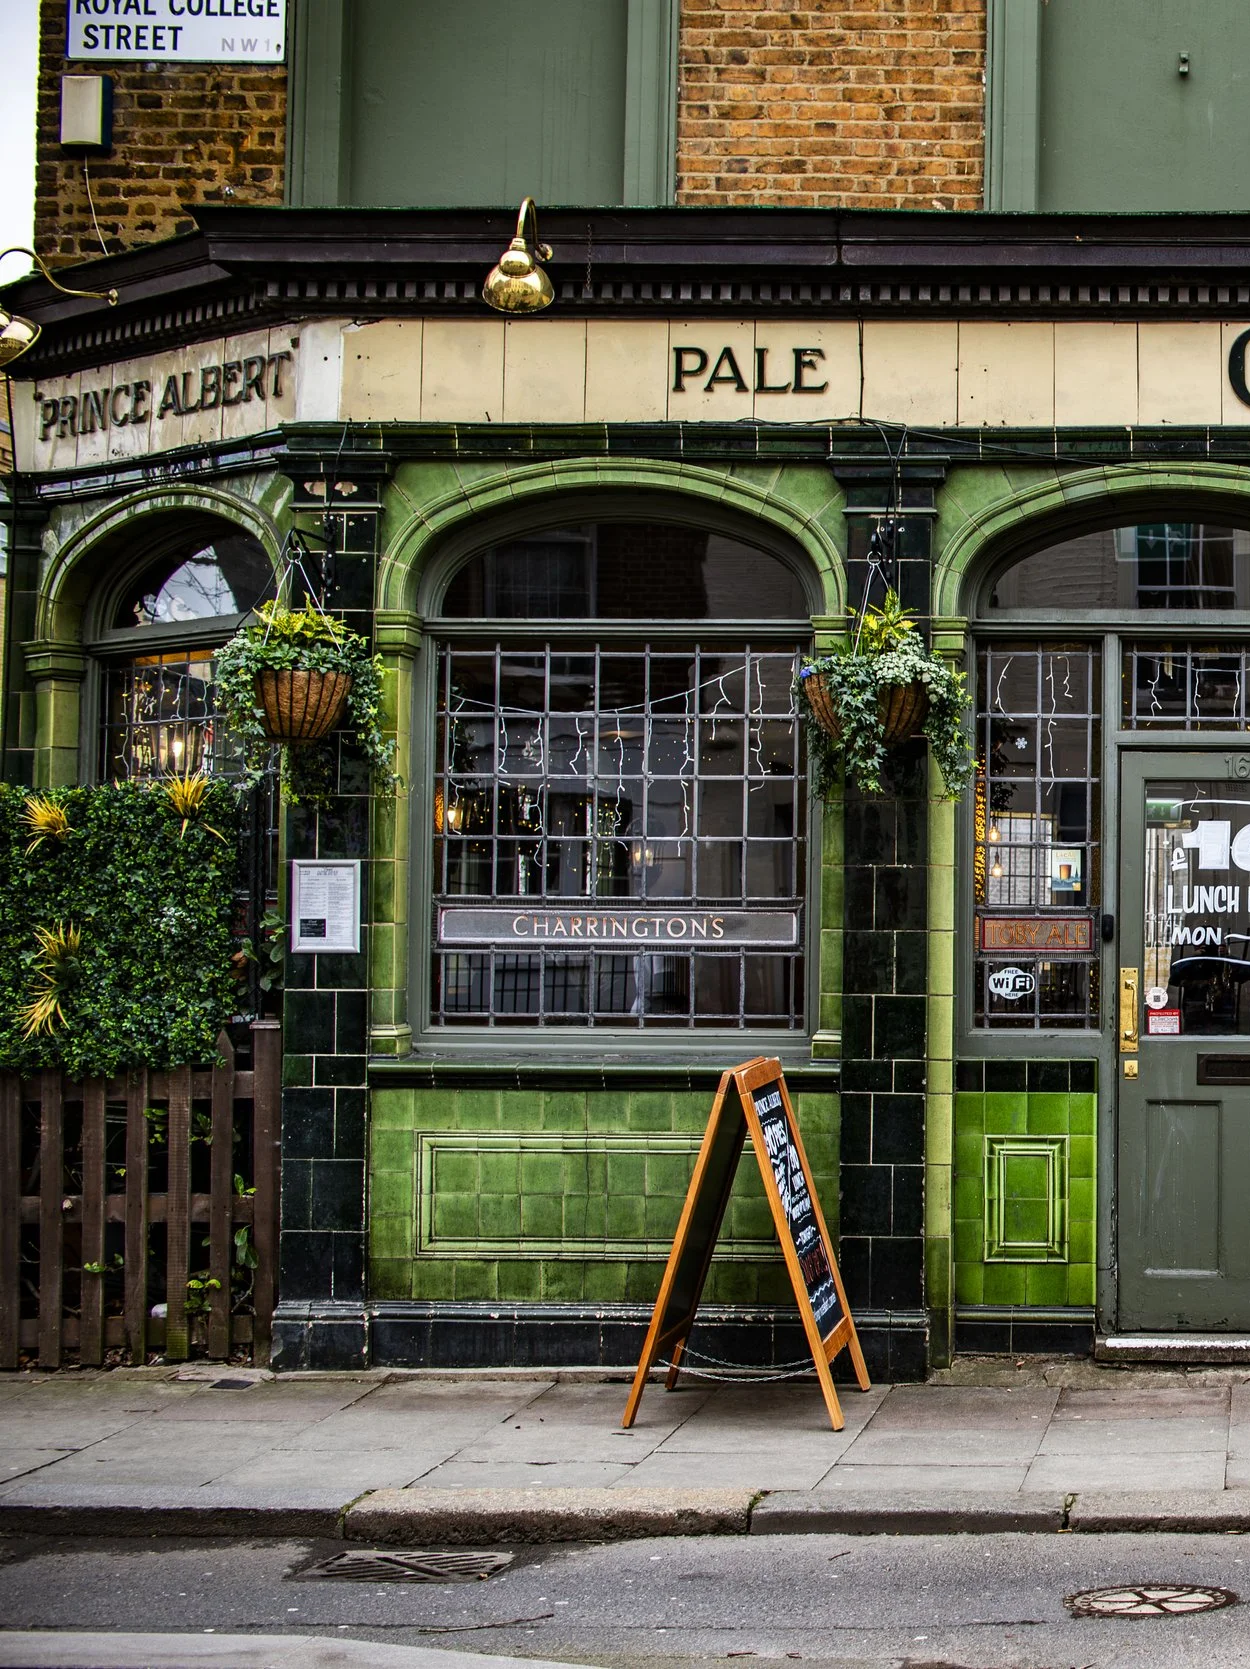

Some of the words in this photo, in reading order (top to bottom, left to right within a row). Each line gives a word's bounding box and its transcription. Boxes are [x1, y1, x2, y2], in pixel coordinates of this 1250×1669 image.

[75, 0, 156, 15] ROYAL
[169, 0, 280, 17] COLLEGE
[82, 24, 183, 50] STREET
[672, 345, 828, 395] PALE
[37, 379, 151, 441] PRINCE
[157, 352, 291, 419] ALBERT
[1167, 885, 1240, 914] LUNCH
[512, 913, 725, 939] CHARRINGTON'S
[986, 923, 1041, 945] TOBY
[1045, 923, 1087, 945] ALE
[1172, 926, 1222, 946] MON
